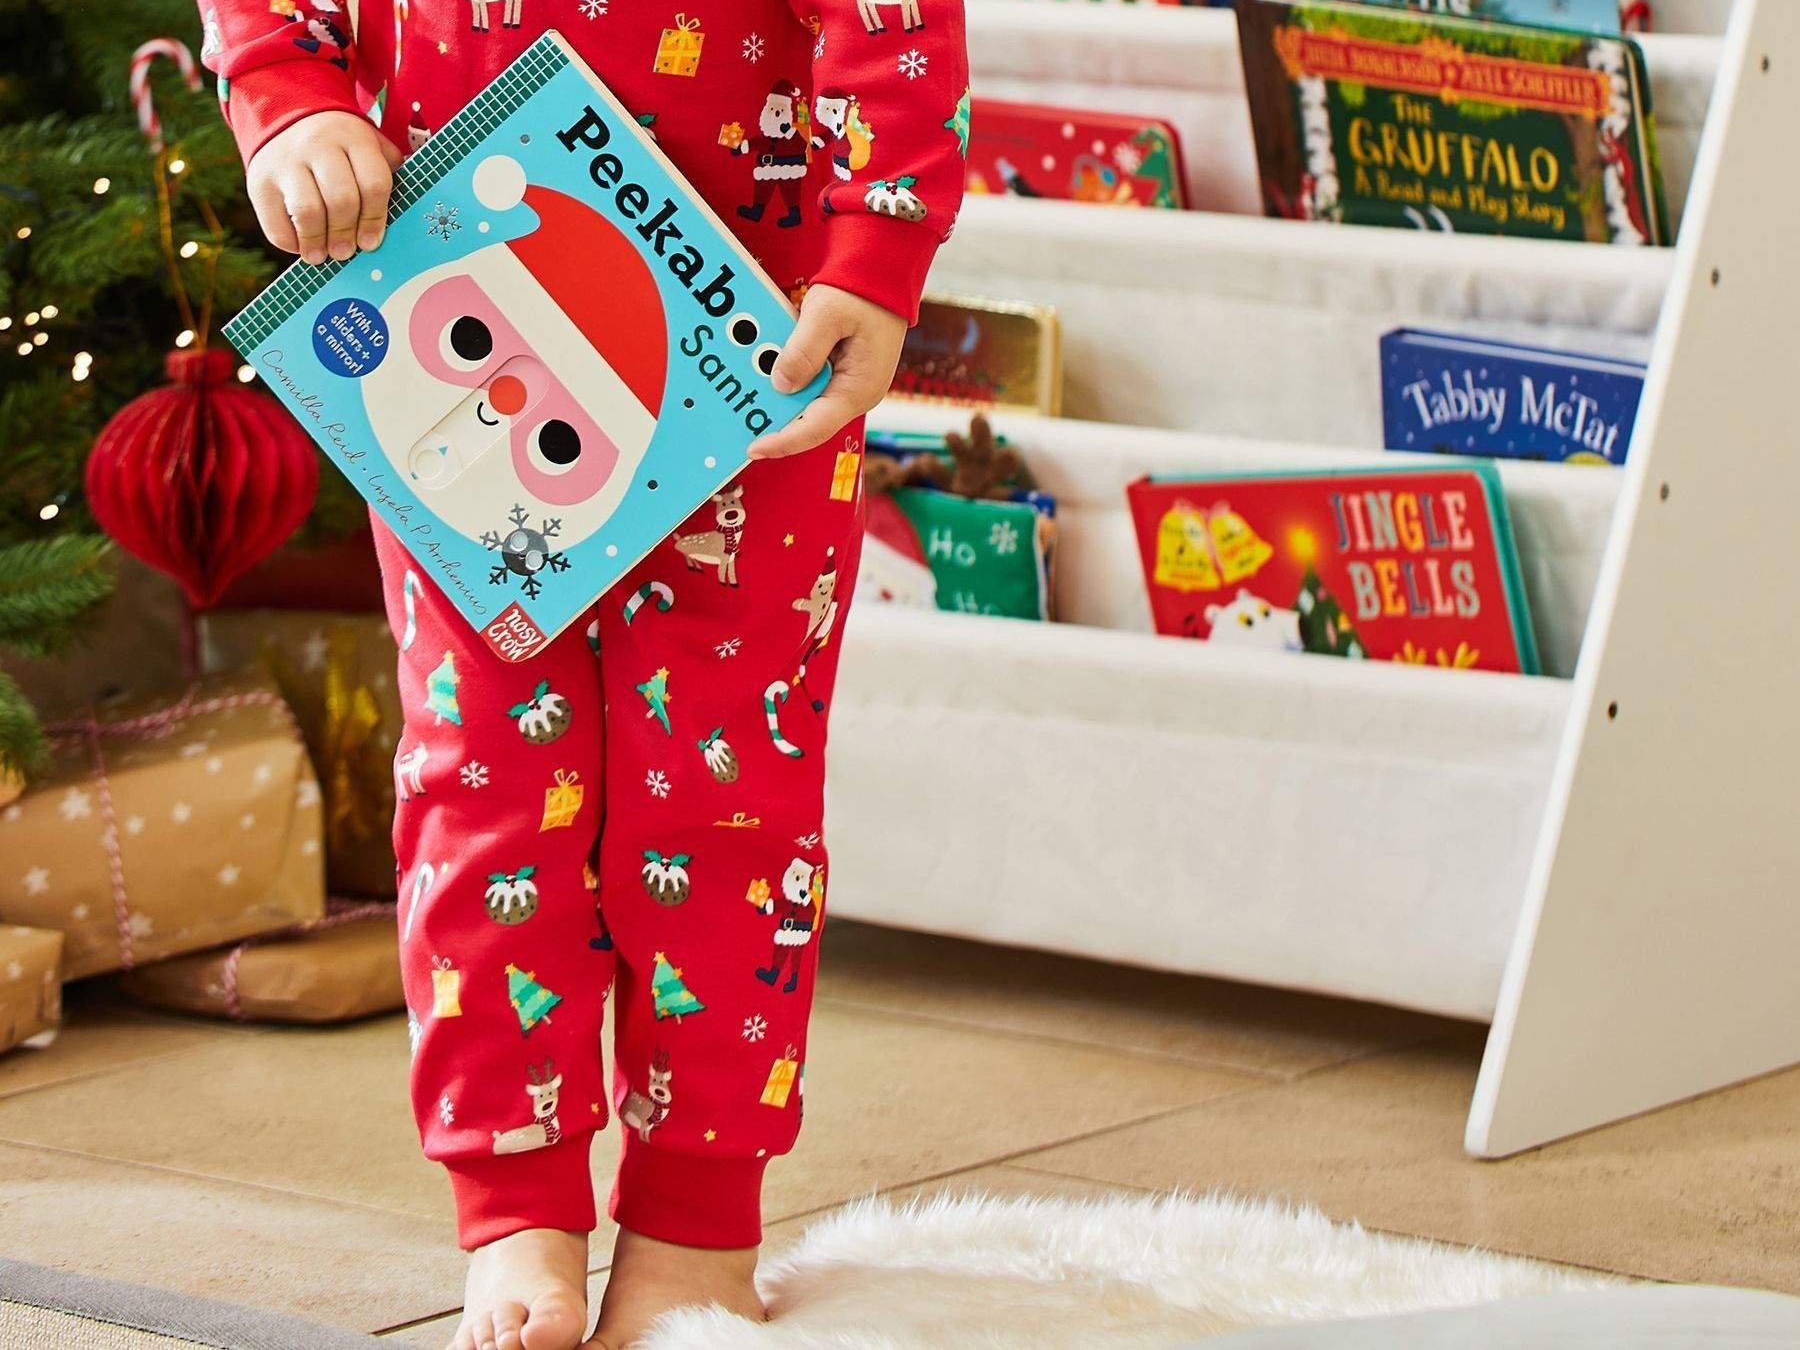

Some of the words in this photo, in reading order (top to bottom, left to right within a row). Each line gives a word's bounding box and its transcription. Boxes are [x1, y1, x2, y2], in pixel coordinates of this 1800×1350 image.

[1348, 117, 1559, 193] GRUFFALO
[1354, 164, 1371, 197] A
[1377, 168, 1424, 205] Read
[1428, 180, 1463, 208] and
[1467, 184, 1509, 223] Play
[1512, 192, 1566, 232] Story
[317, 324, 328, 336] a
[326, 334, 364, 375] mirror!
[330, 315, 363, 352] sliders
[346, 301, 372, 334] With
[368, 330, 385, 347] 10
[261, 349, 320, 423] Camilla
[680, 324, 773, 436] Santa
[1402, 368, 1507, 434] Tabby
[1520, 374, 1620, 456] McTat
[322, 422, 366, 465] Reid
[368, 474, 414, 526] Ingela
[1329, 491, 1475, 553] JINGLE
[410, 523, 432, 535] P
[928, 527, 977, 567] Ho
[416, 538, 487, 616] Arrhenius
[1347, 559, 1481, 621] BELLS
[504, 608, 542, 648] nosy
